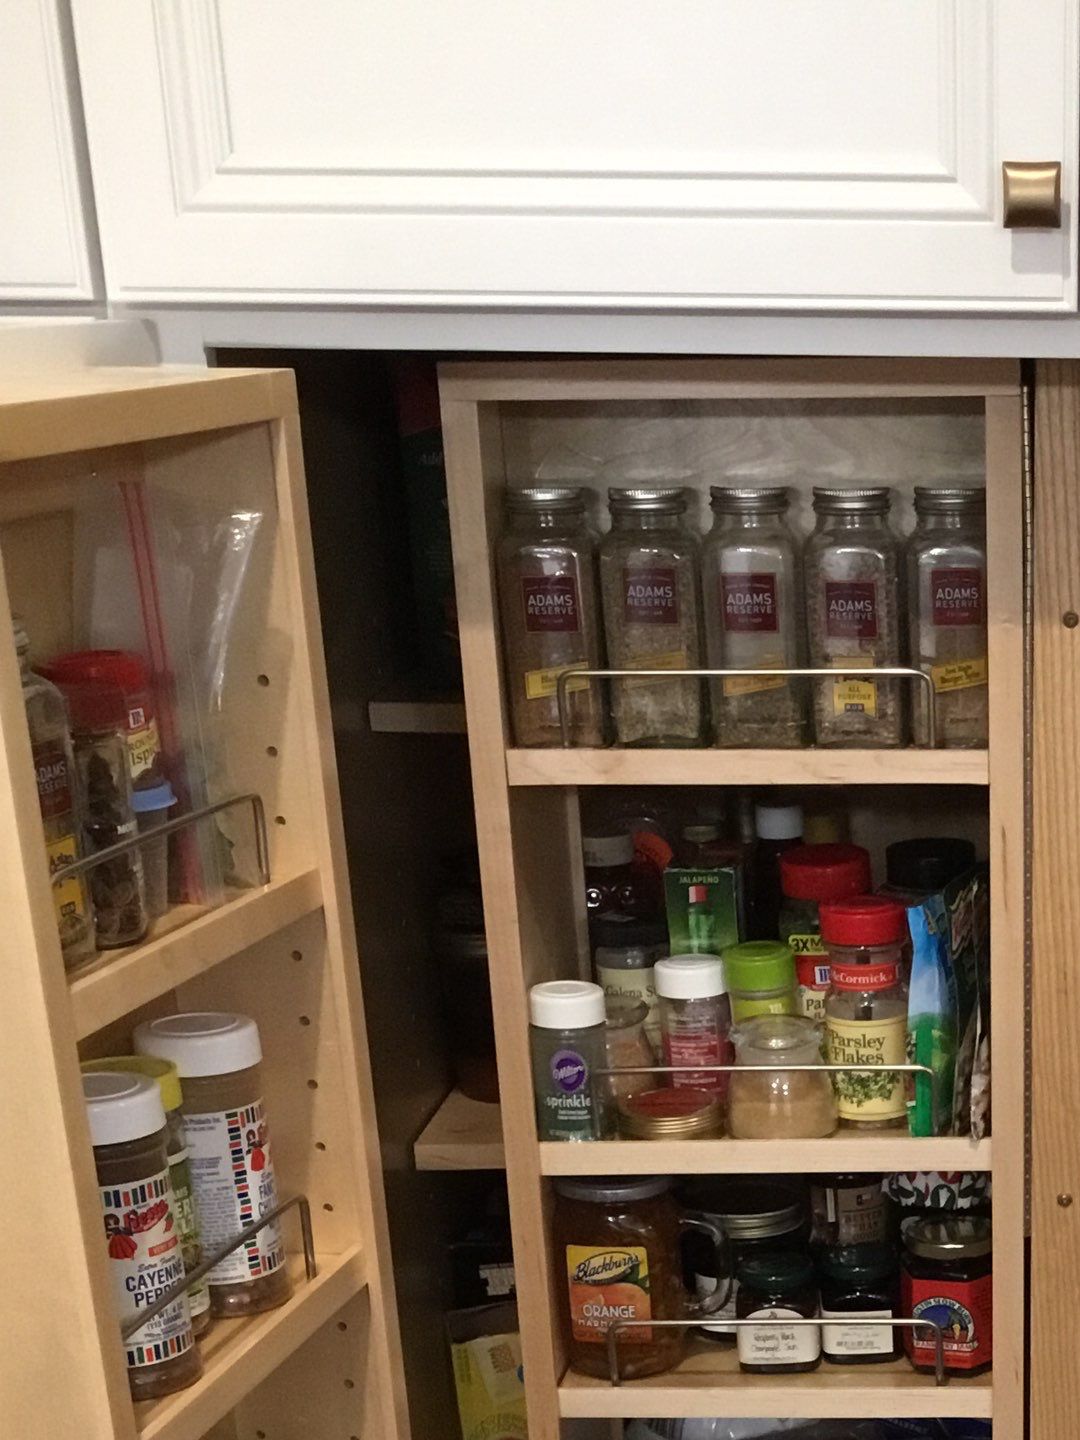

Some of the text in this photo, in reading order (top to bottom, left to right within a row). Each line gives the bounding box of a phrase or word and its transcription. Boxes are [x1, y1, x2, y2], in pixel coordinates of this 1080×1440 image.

[626, 585, 673, 598] ADAMS
[935, 587, 979, 600] ADAMS
[527, 594, 574, 607] ADAMS
[626, 597, 673, 607] RESERVE
[726, 592, 772, 605] ADAMS
[935, 599, 979, 609] RESERVE
[527, 606, 574, 616] RESERVE
[726, 605, 772, 615] RESERVE
[828, 600, 873, 612] ADAMS
[828, 611, 873, 621] RESERVE
[791, 938, 810, 952] 3X
[831, 967, 888, 985] cCormick
[831, 1030, 887, 1051] Parsley
[831, 1045, 885, 1064] Flakes
[582, 1303, 636, 1318] ORANGE
